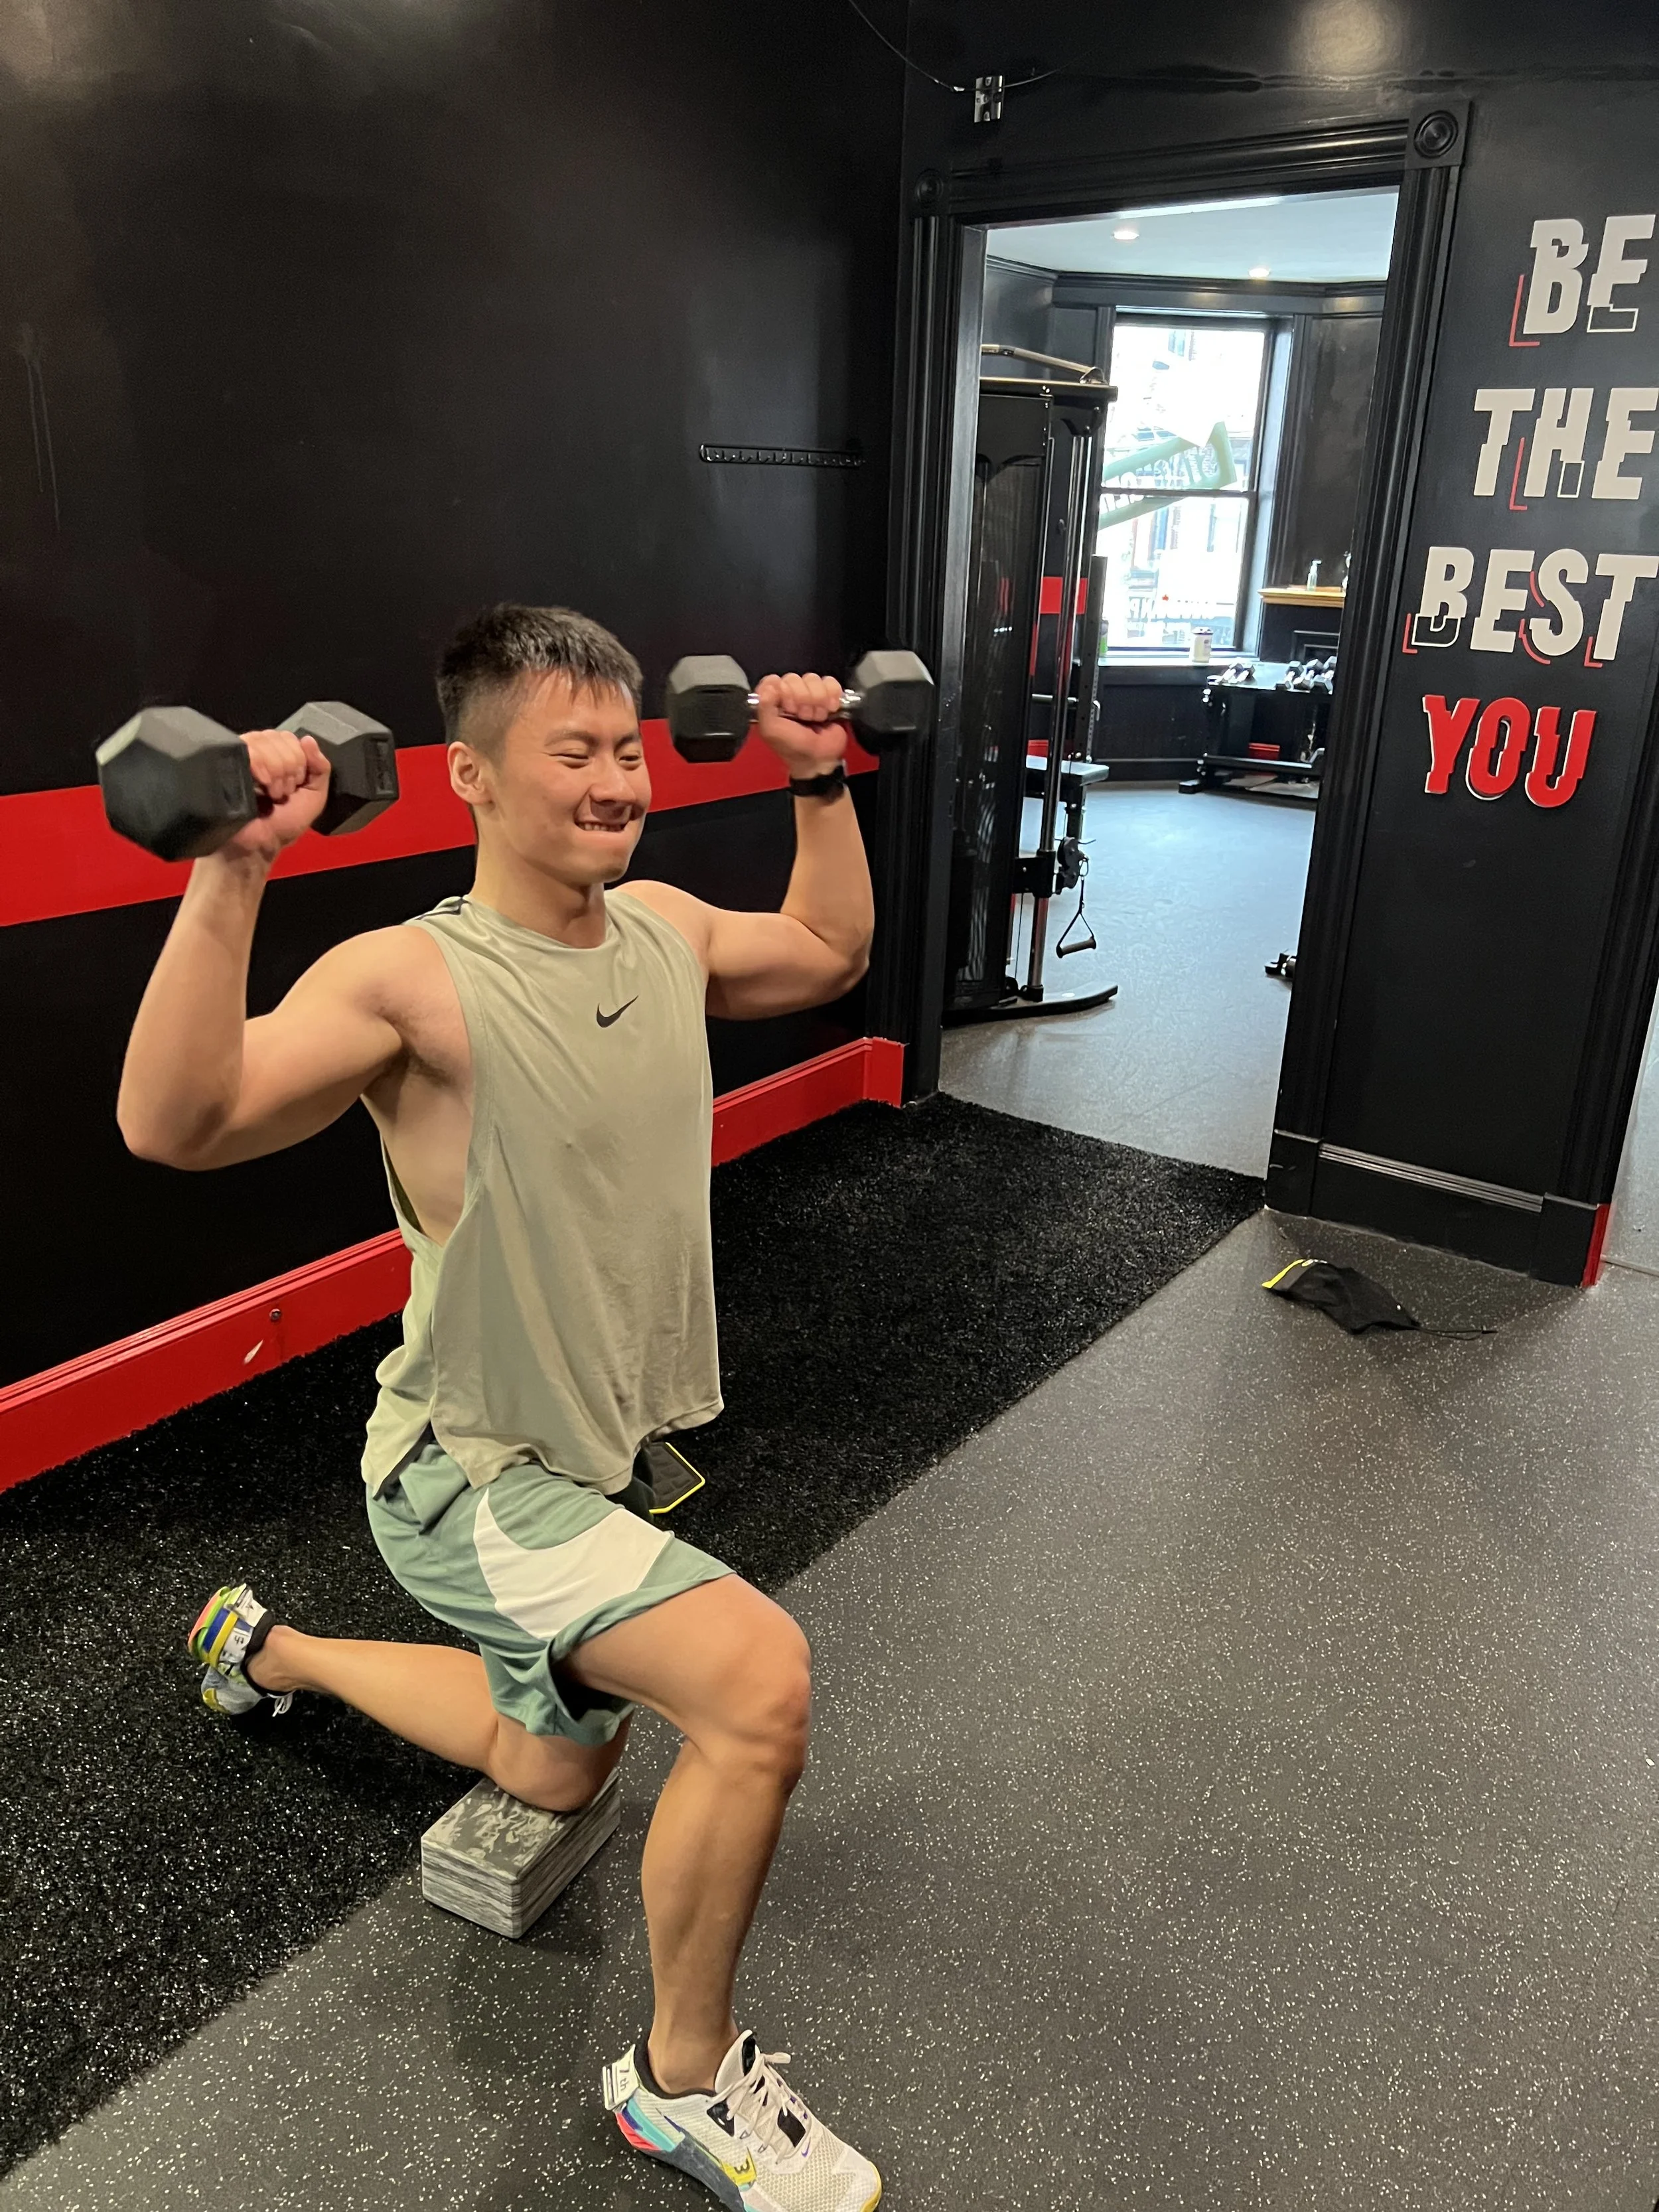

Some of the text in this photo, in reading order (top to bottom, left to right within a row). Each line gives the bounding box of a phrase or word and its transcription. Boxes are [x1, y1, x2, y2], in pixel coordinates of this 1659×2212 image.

[1523, 214, 1656, 334] BE
[1473, 387, 1659, 500] THE
[1411, 546, 1659, 661] BEST
[1421, 694, 1597, 809] YOU
